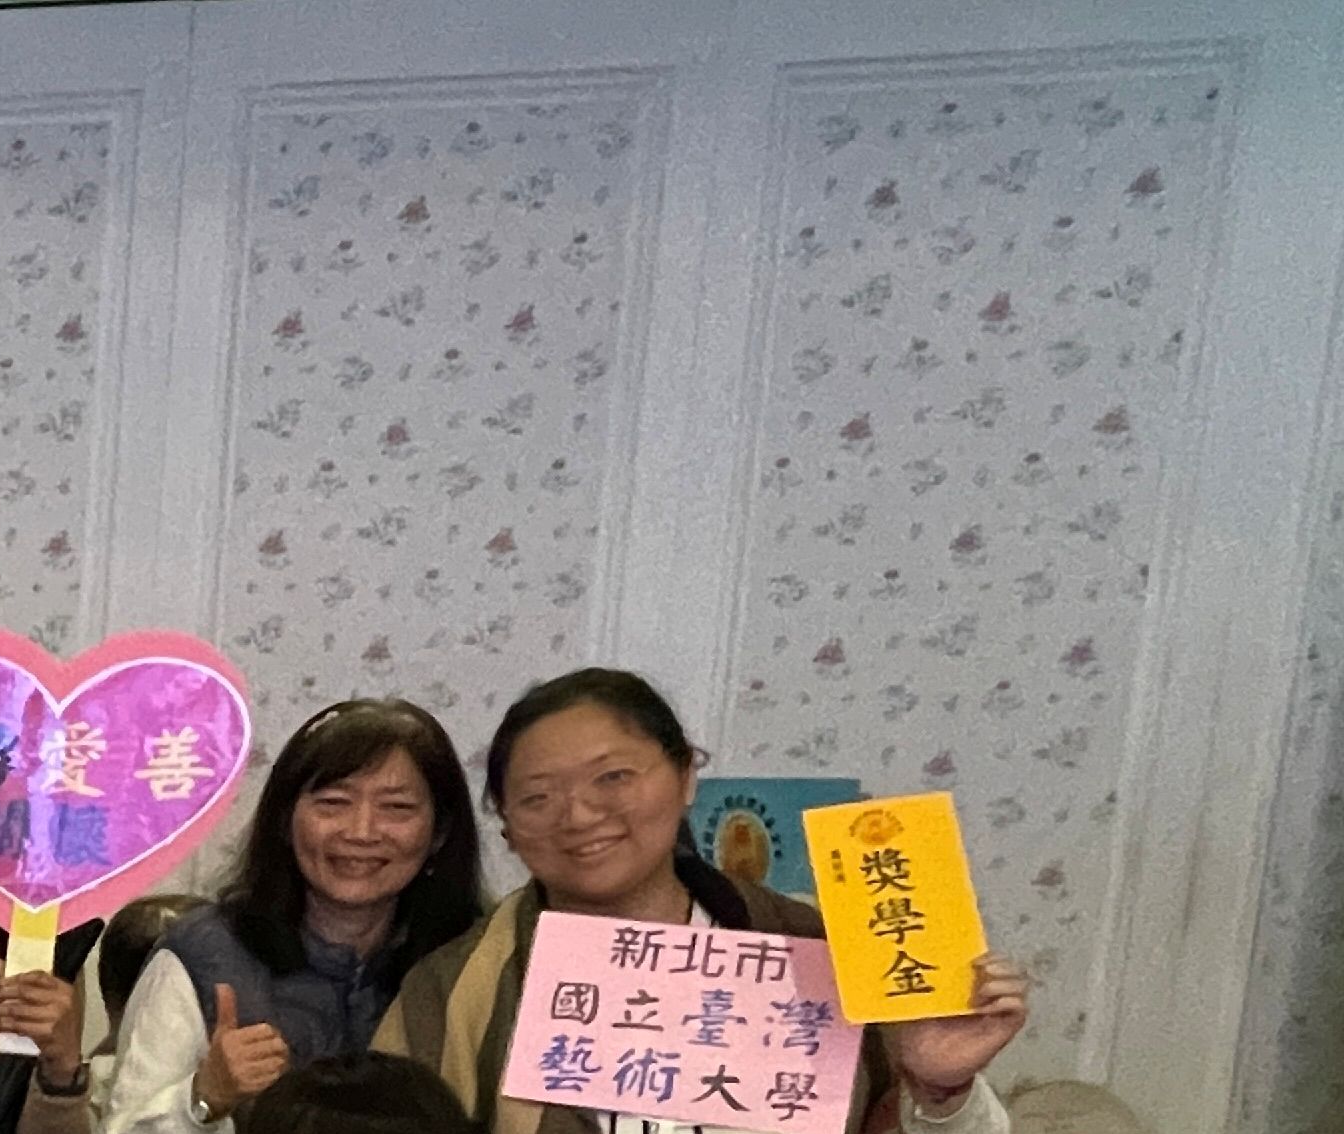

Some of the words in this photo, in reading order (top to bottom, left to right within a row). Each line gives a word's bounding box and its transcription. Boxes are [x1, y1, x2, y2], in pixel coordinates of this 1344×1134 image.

[609, 926, 793, 986] 新北市
[860, 847, 940, 999] 獎學金
[550, 982, 835, 1056] 國立臺灣
[538, 1034, 820, 1121] 藝術大學
